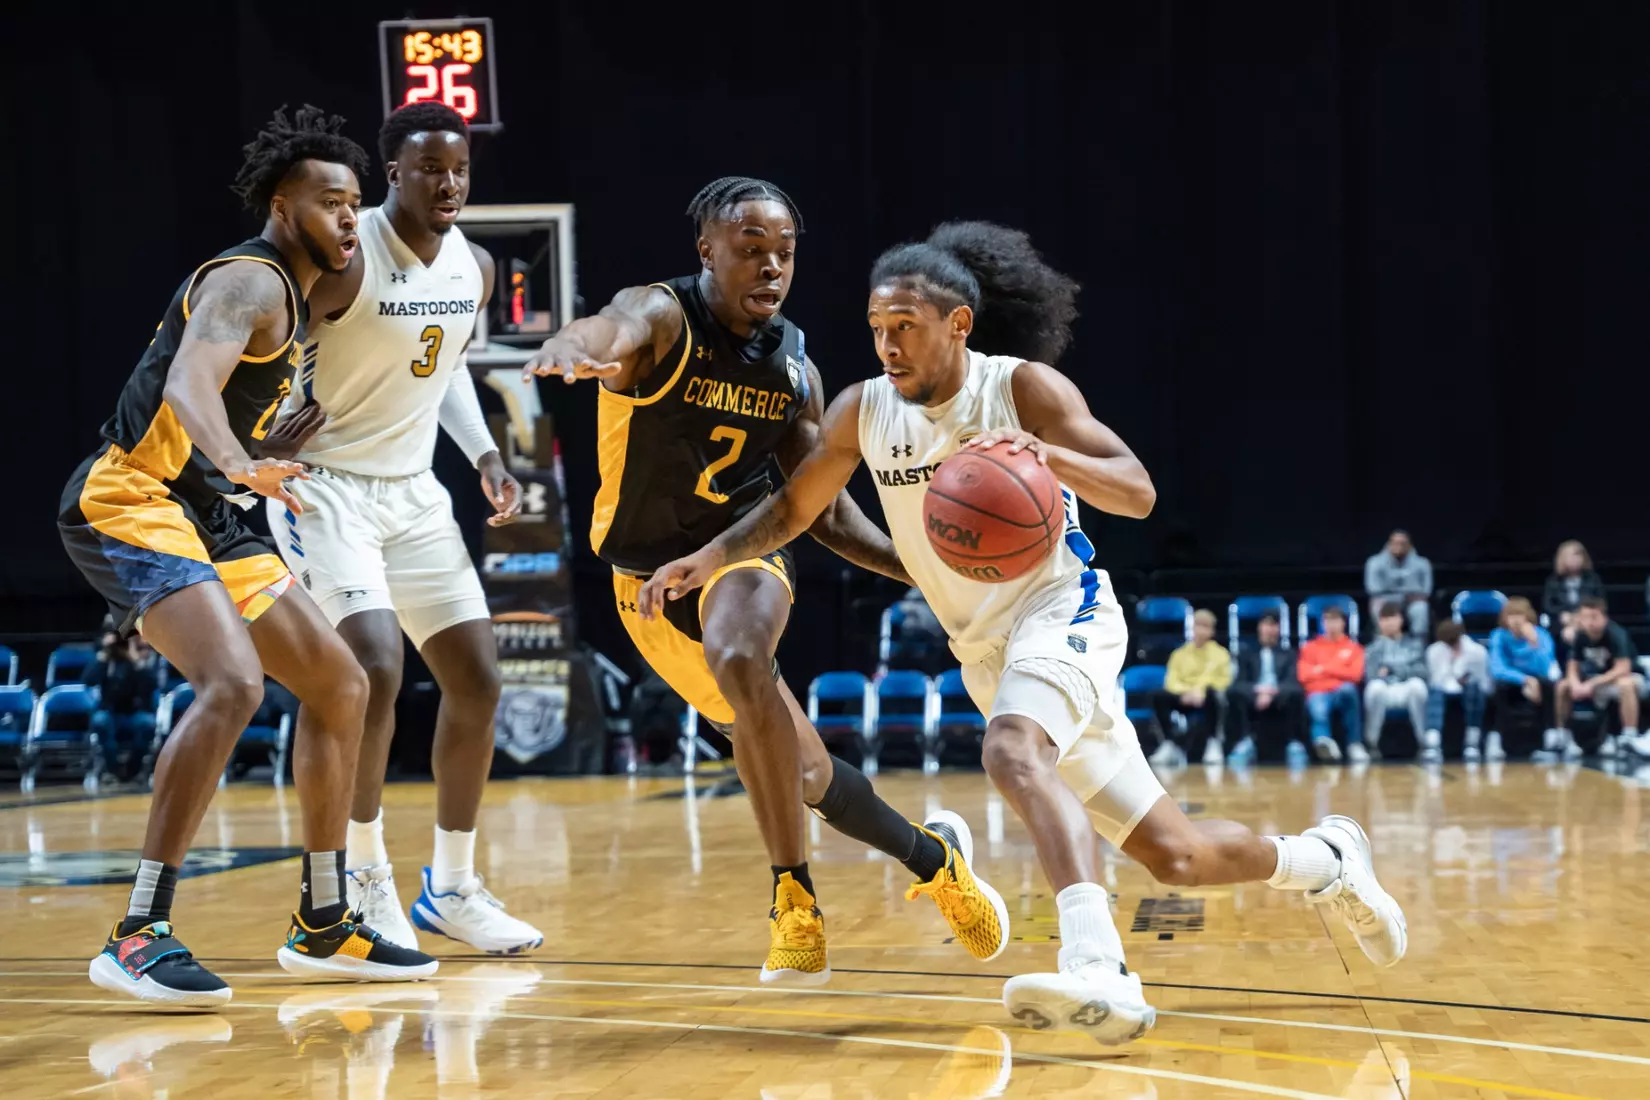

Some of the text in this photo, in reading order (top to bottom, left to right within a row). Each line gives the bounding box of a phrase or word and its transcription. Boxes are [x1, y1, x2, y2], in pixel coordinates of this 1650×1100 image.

[404, 30, 482, 64] 15:43
[406, 64, 477, 118] 26
[378, 300, 475, 316] MASTODONS
[410, 325, 444, 377] 3
[683, 376, 792, 420] COMMERCE
[694, 425, 748, 504] 2
[928, 513, 983, 550] NCAA
